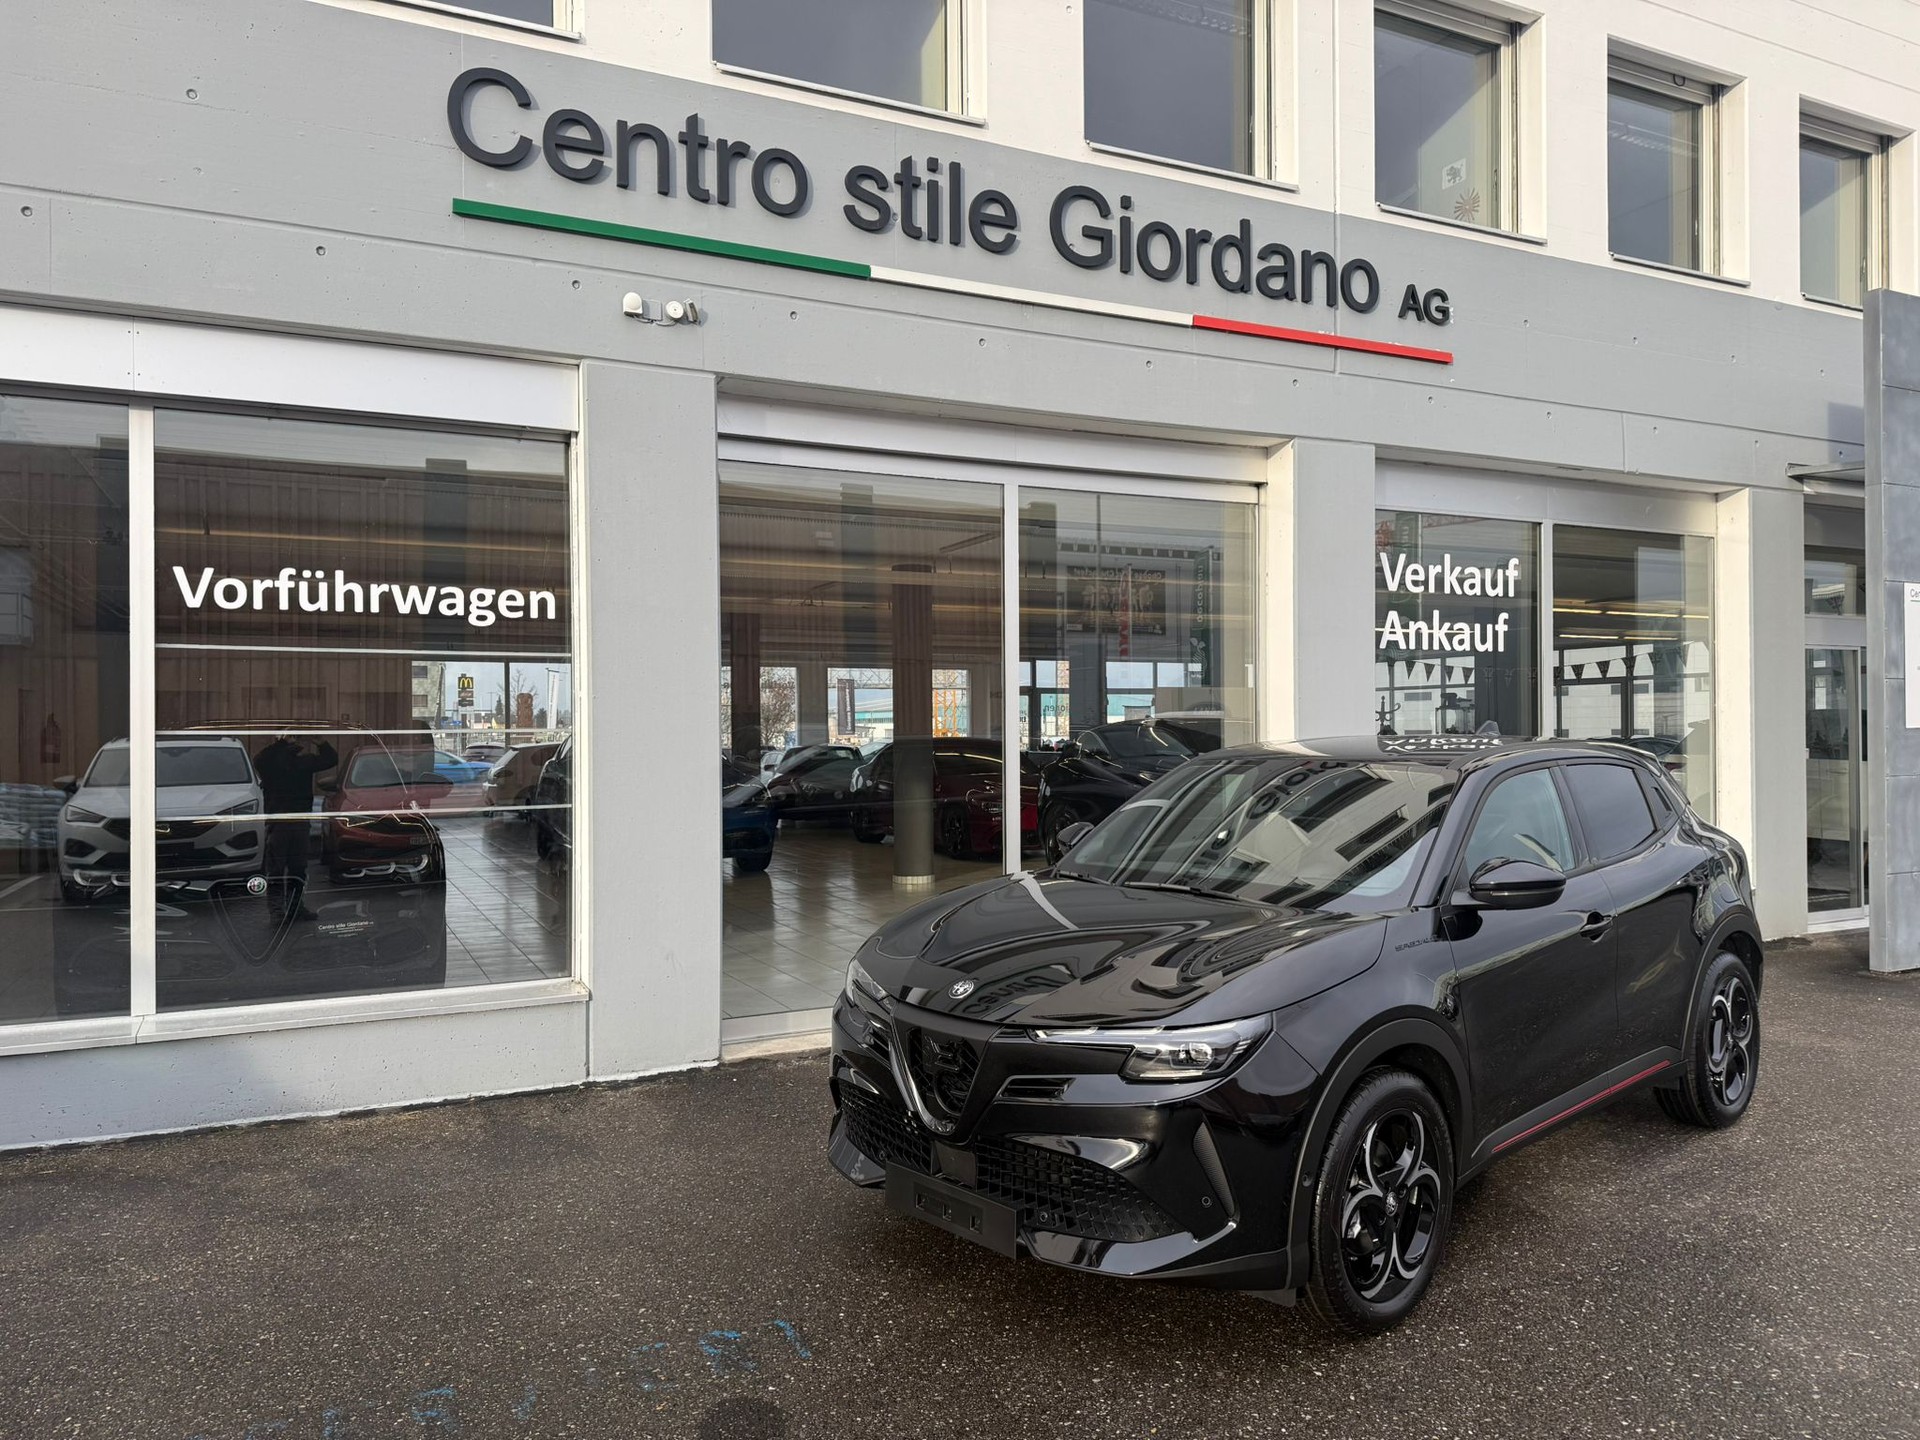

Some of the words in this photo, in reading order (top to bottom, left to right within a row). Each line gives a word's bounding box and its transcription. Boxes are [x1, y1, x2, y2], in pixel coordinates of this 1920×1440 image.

[447, 67, 809, 219] Centro
[843, 156, 1019, 256] stile
[1049, 186, 1380, 314] Giordano
[1397, 283, 1450, 327] AG
[172, 565, 557, 627] Vorführwagen
[1379, 551, 1520, 598] Verkauf
[1910, 588, 1920, 599] Ce
[1378, 609, 1510, 654] Ankauf
